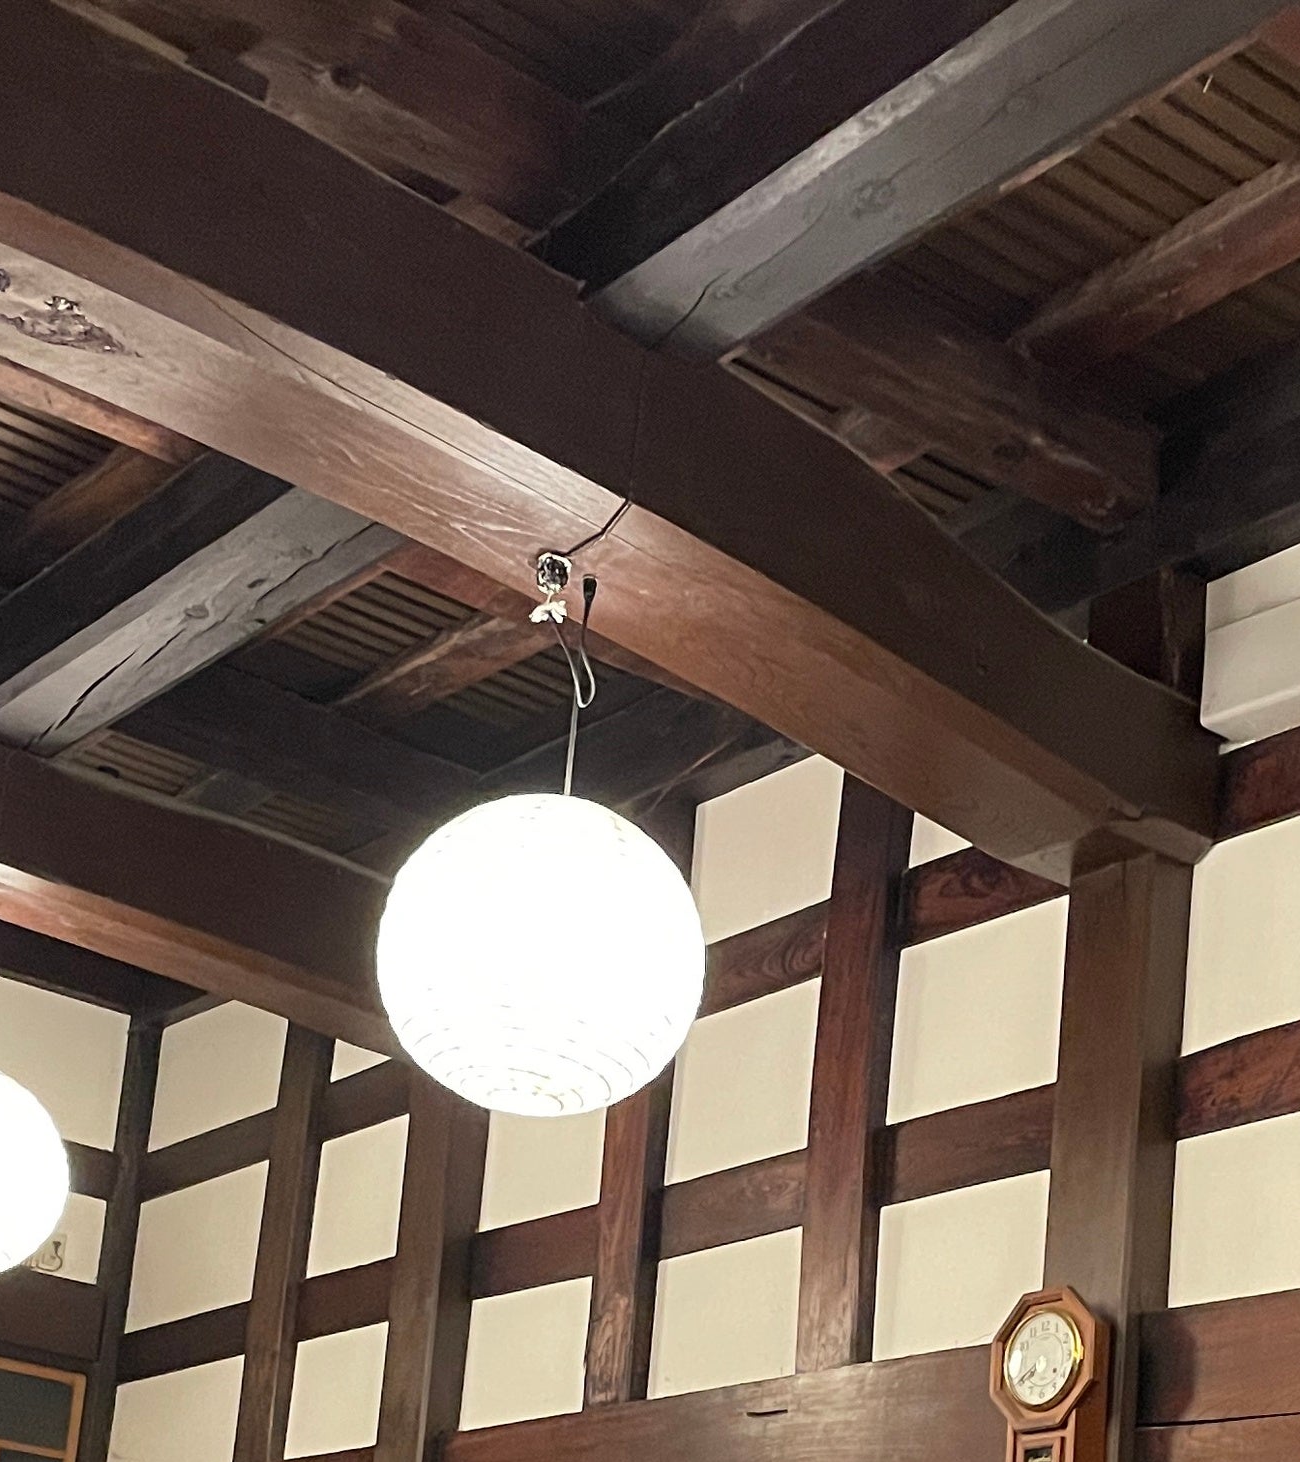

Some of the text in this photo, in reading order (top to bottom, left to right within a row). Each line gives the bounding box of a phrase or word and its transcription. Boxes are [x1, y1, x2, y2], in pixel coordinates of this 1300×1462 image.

[1041, 1320, 1050, 1332] 12
[1062, 1333, 1069, 1344] 2
[1039, 1388, 1045, 1399] 6
